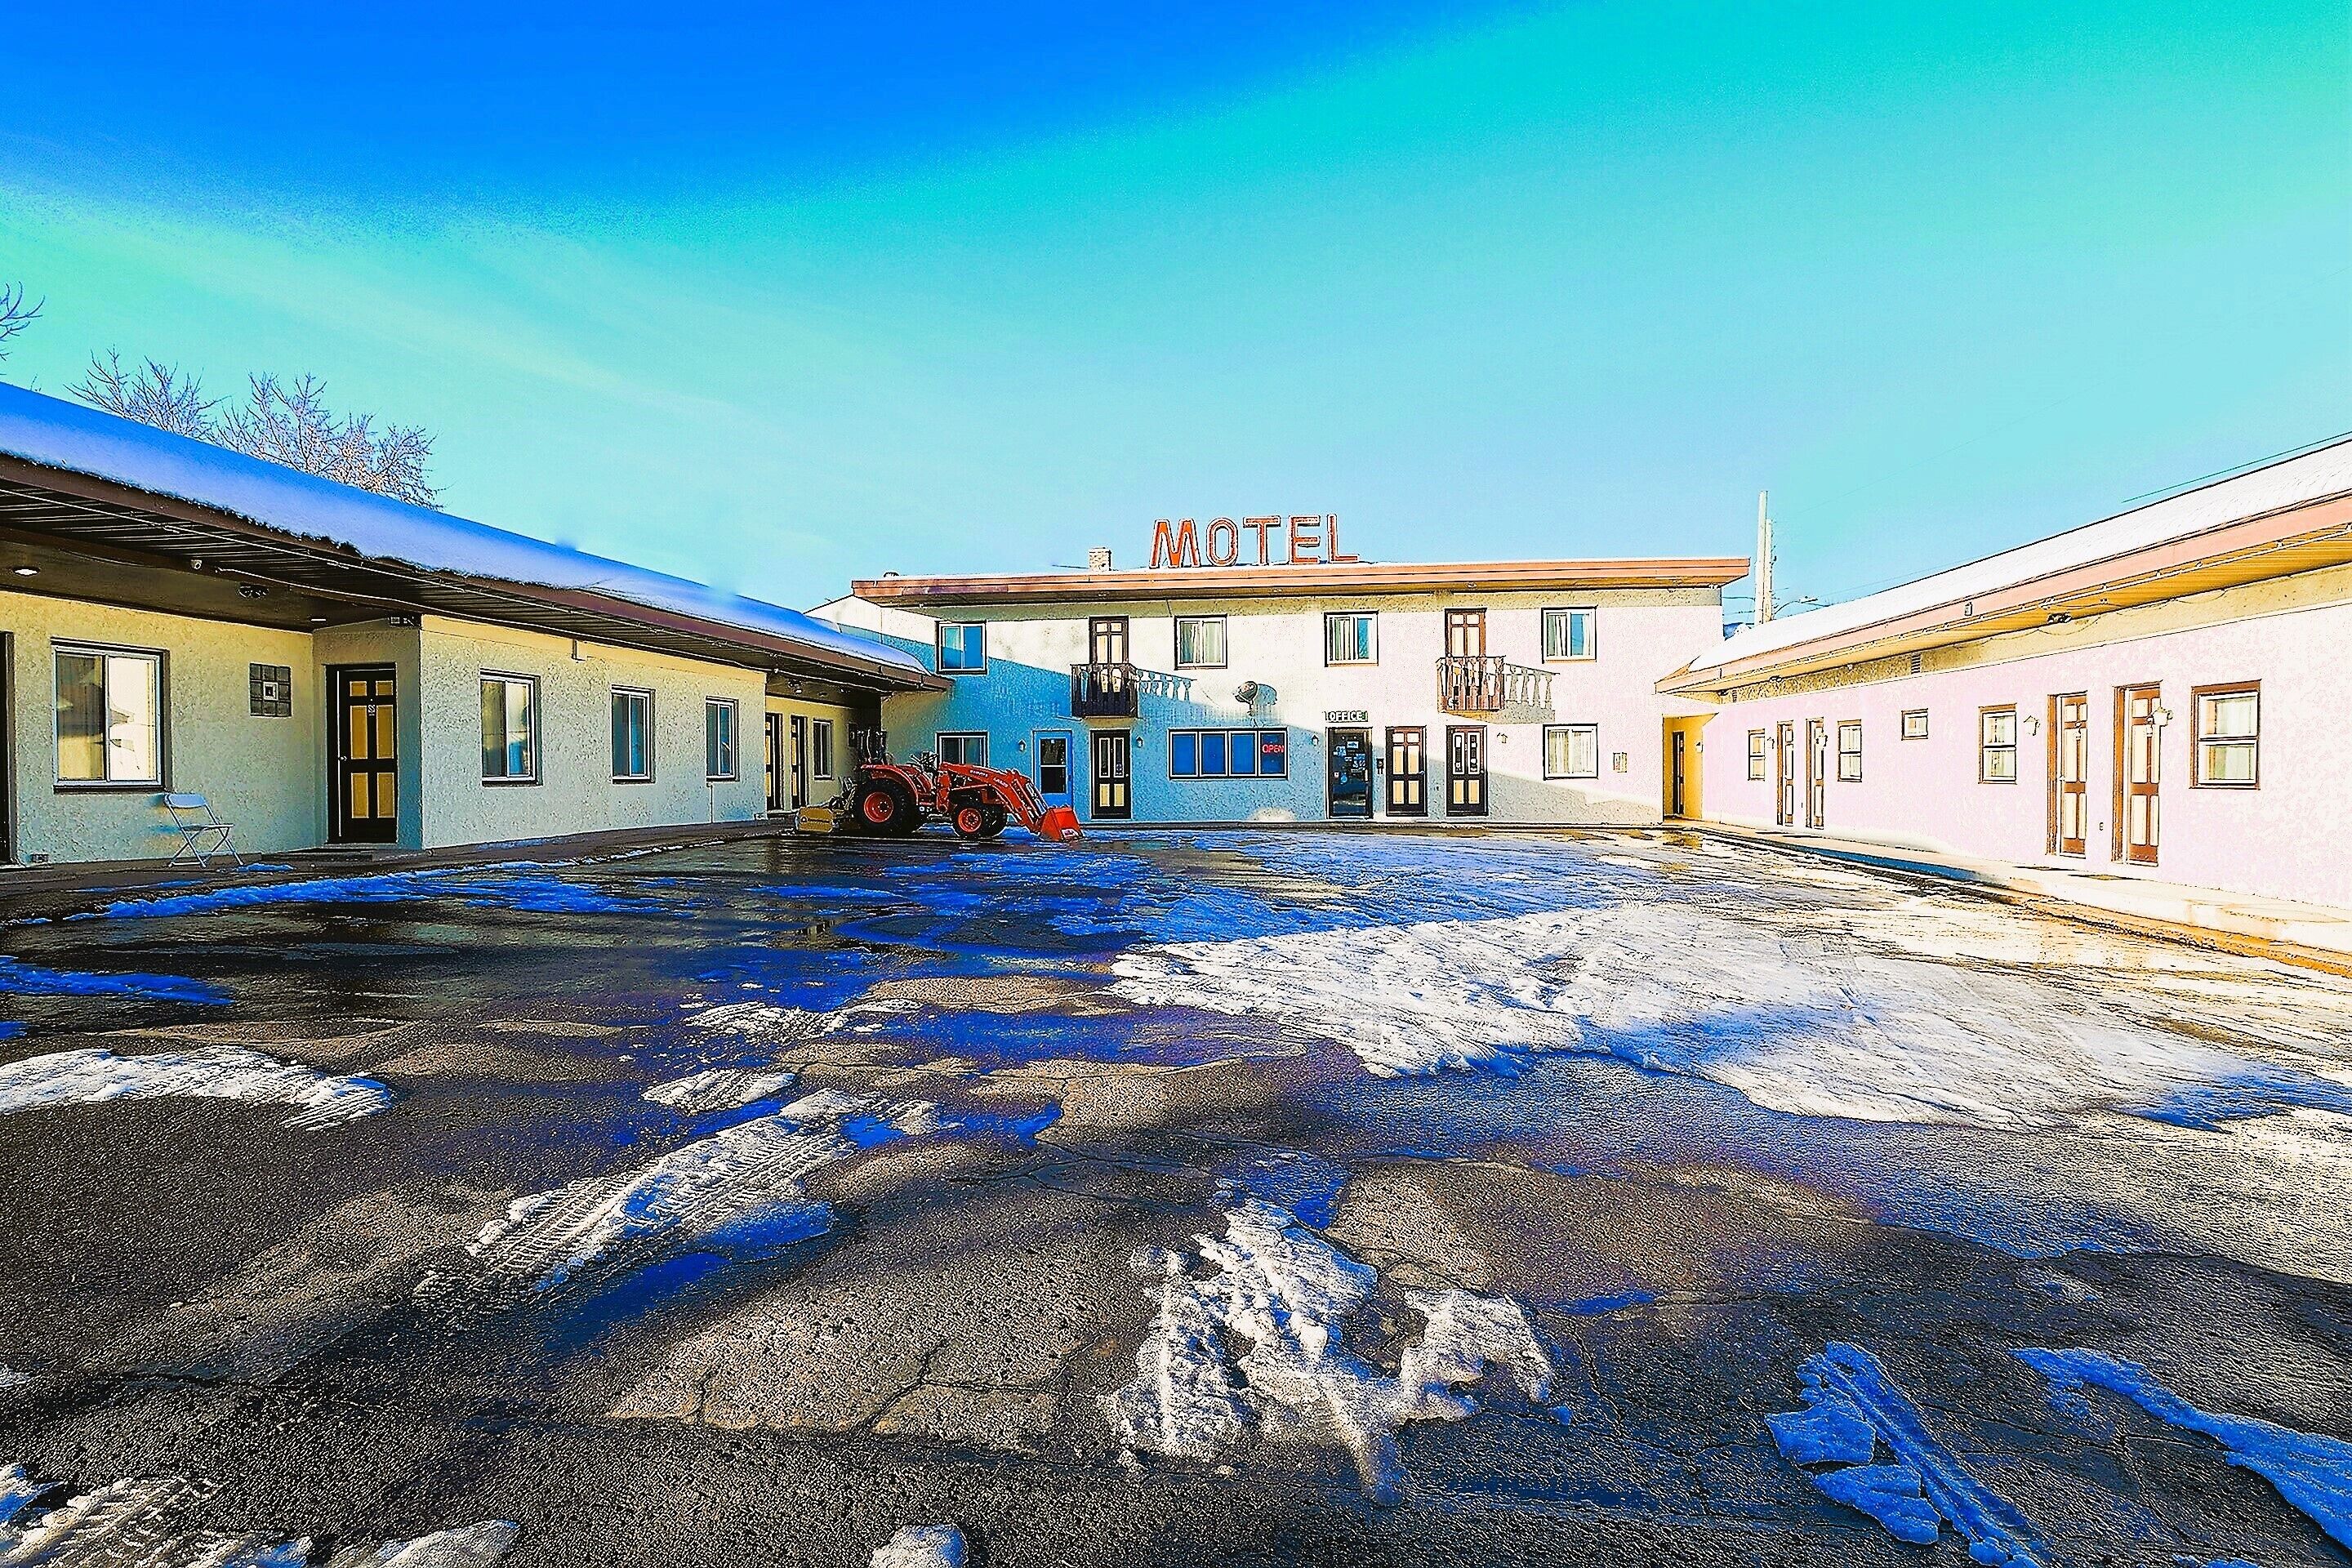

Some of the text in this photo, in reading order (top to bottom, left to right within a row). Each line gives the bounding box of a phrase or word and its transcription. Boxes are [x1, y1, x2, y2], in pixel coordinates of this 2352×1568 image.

[1149, 514, 1360, 568] MOTEL
[1329, 710, 1363, 721] OFFICE
[1262, 744, 1285, 753] OPEN
